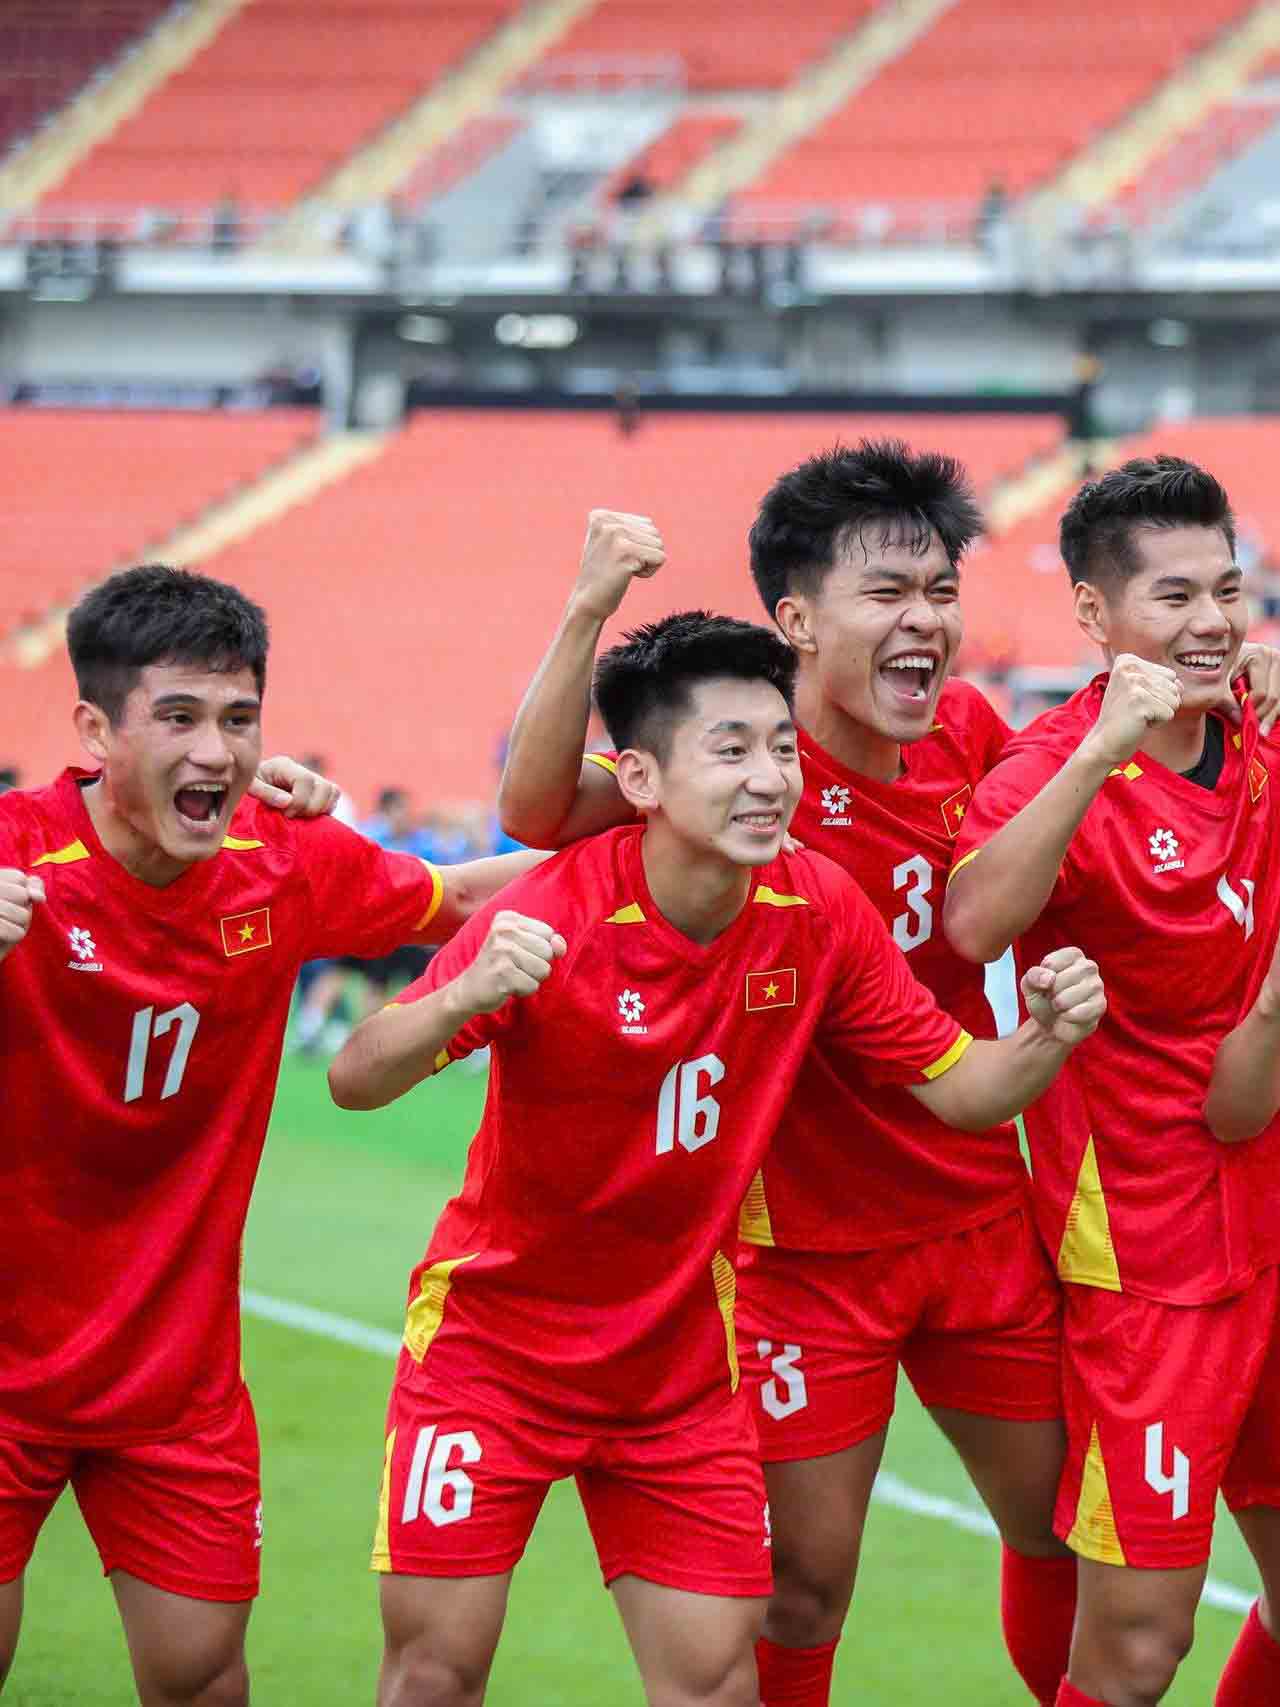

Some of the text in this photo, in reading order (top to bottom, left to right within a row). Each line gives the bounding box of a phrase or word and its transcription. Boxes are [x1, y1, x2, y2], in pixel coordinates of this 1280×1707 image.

[892, 854, 933, 953] 3
[1216, 872, 1255, 942] 4
[124, 1001, 201, 1103] 17
[655, 1052, 726, 1156] 16
[757, 1339, 808, 1421] 3
[402, 1423, 483, 1528] 16
[1144, 1420, 1190, 1521] 4
